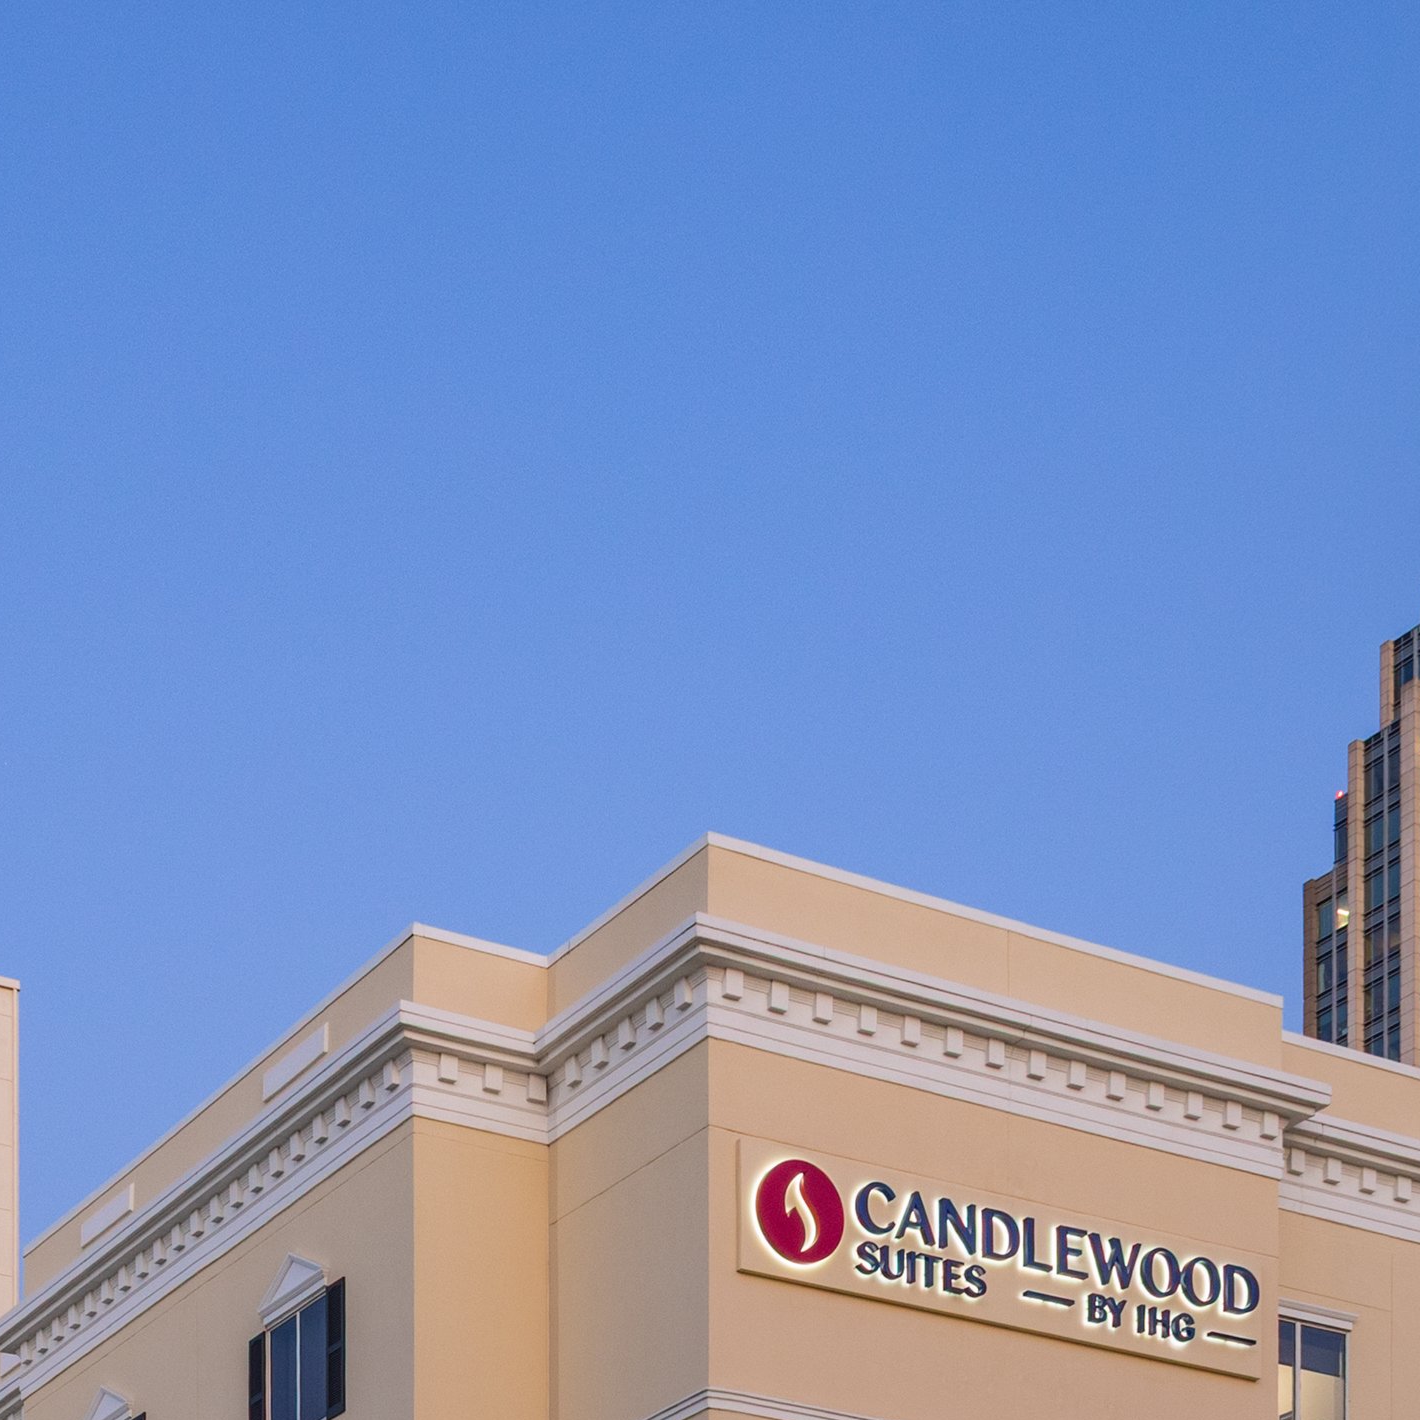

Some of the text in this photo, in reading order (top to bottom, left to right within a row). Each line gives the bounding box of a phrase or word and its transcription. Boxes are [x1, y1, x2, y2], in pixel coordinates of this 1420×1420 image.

[855, 1181, 1260, 1315] CANDLEWOOD
[855, 1241, 987, 1298] SUITES
[1087, 1292, 1195, 1342] BY IHG
